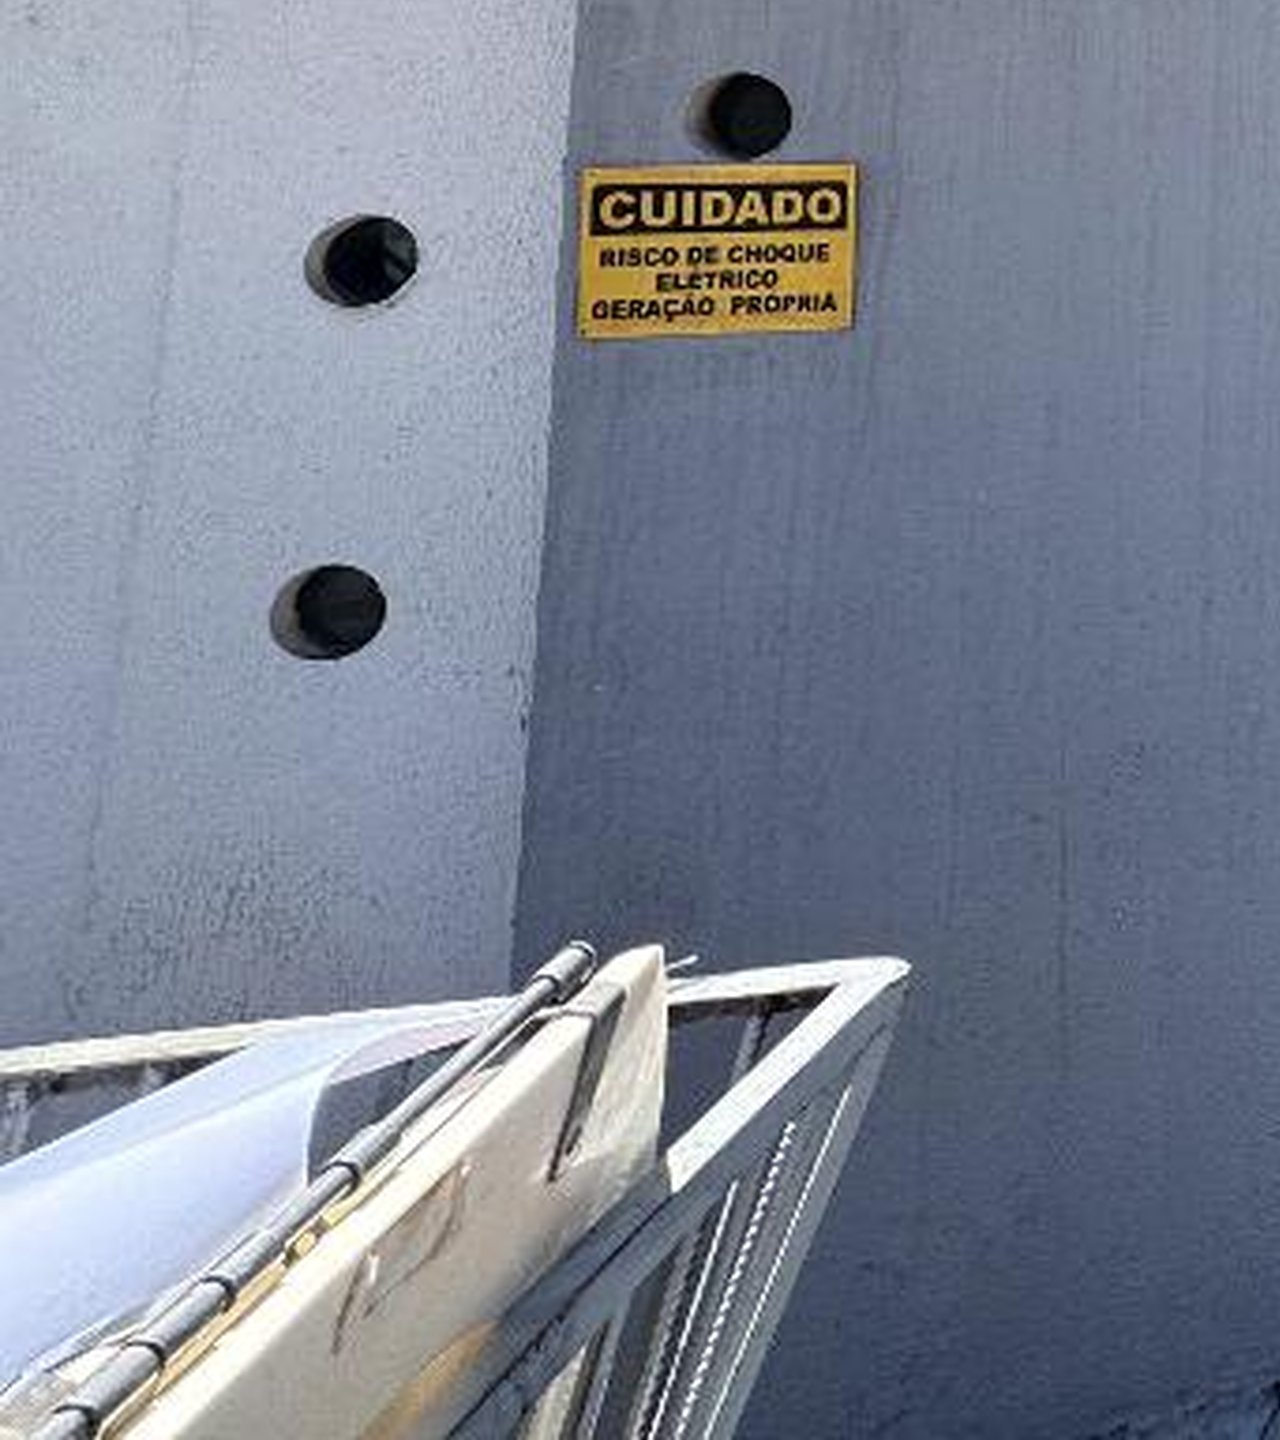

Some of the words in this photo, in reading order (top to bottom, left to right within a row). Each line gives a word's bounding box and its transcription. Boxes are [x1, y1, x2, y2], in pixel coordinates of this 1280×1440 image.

[600, 188, 842, 227] CUIDADO
[600, 247, 680, 267] RISCO
[687, 246, 720, 264] DE
[727, 243, 830, 264] CHOQUE
